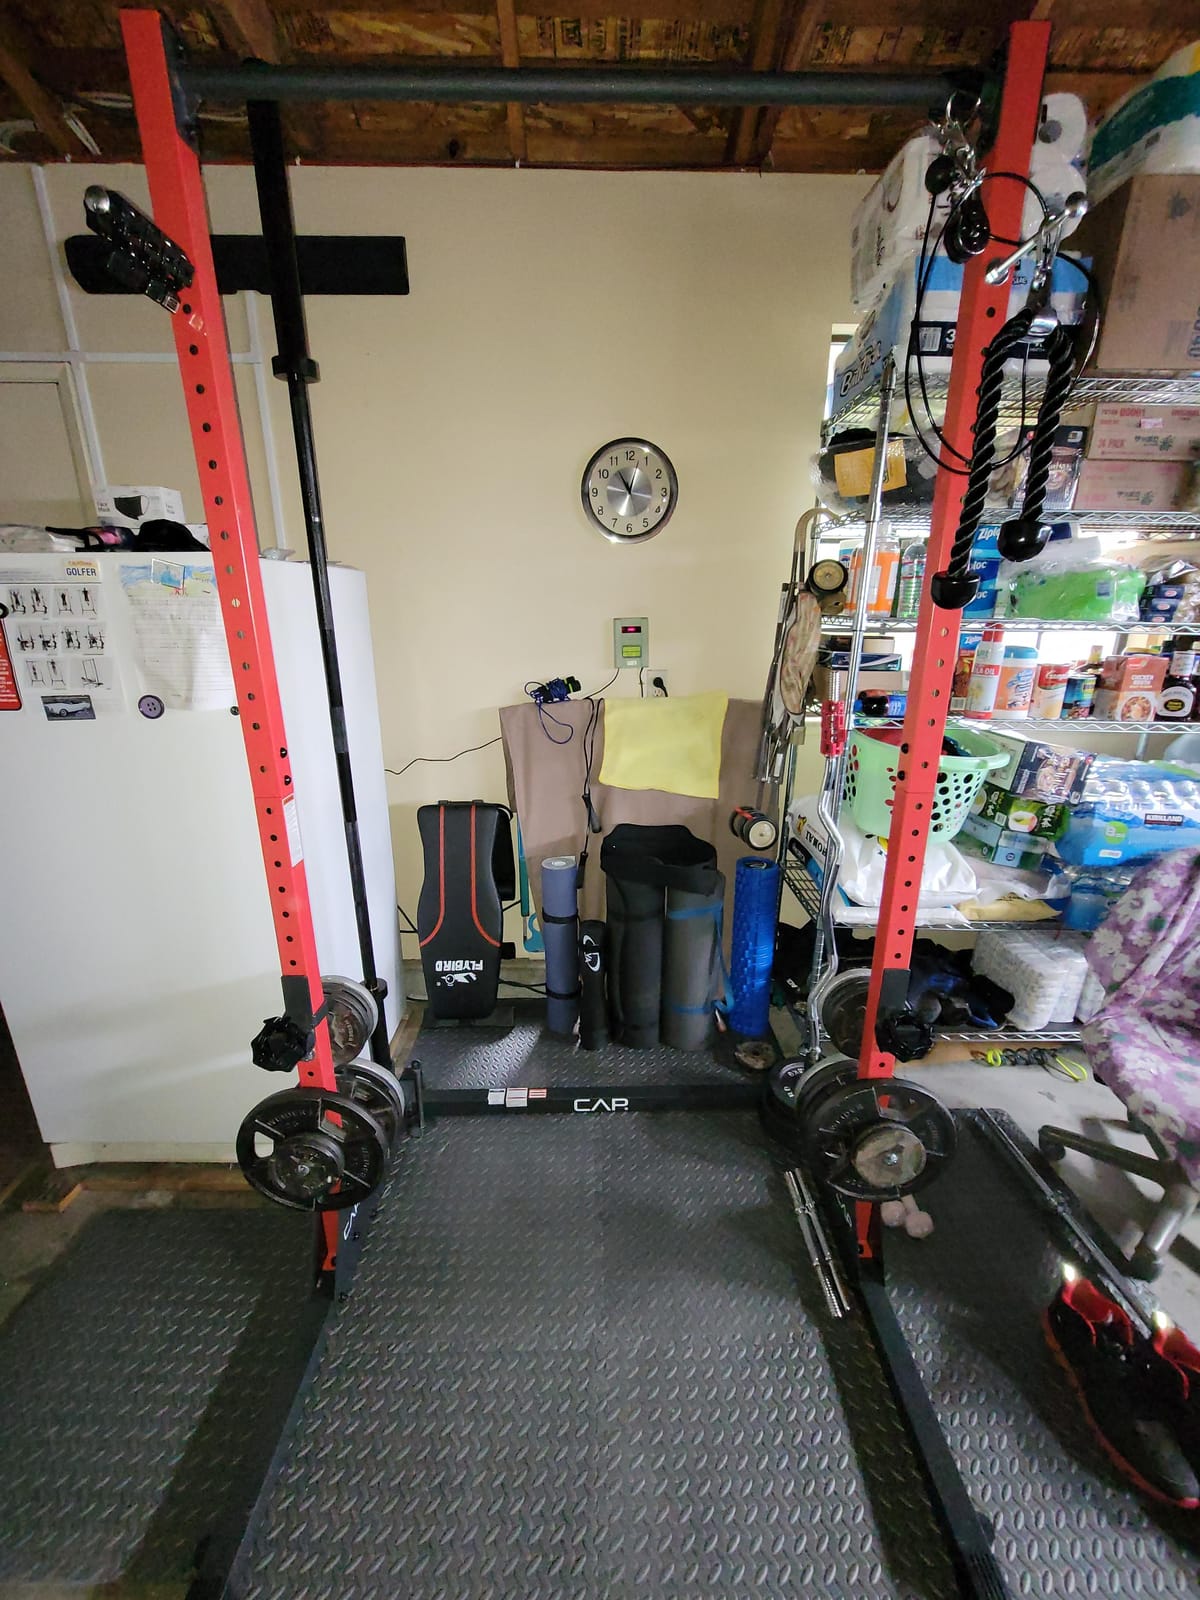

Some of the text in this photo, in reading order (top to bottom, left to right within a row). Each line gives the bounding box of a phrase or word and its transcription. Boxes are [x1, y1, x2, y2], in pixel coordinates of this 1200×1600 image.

[625, 450, 635, 461] 12
[609, 456, 618, 466] 11
[598, 469, 609, 479] 10
[655, 469, 662, 479] 2
[592, 487, 598, 497] 9
[661, 487, 667, 497] 3
[597, 506, 604, 515] 8
[655, 505, 661, 514] 4
[611, 518, 618, 528] 7
[626, 523, 633, 533] 6
[642, 518, 649, 528] 5
[66, 567, 97, 577] GOLFER
[435, 959, 484, 971] FLYBIRD
[573, 1097, 629, 1112] CAP
